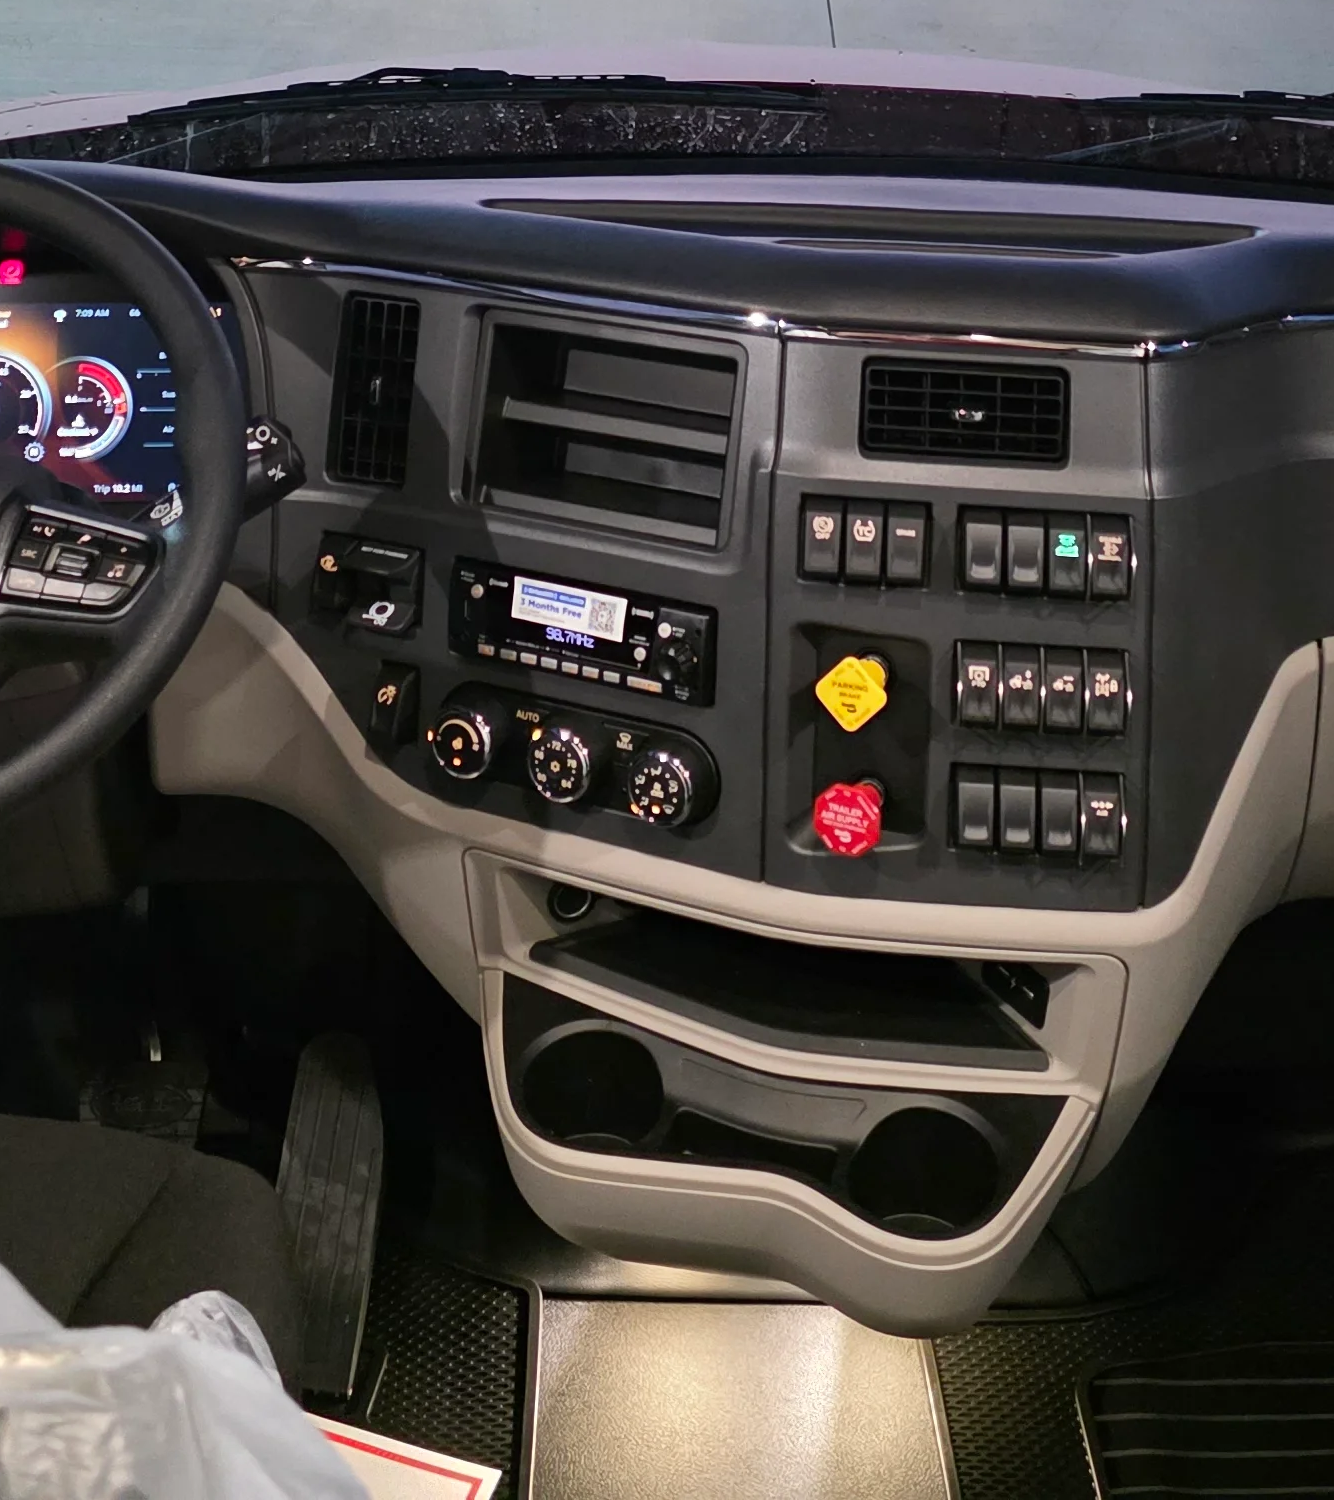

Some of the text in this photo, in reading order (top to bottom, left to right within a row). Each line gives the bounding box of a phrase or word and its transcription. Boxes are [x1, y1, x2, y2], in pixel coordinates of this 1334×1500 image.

[75, 308, 110, 318] 7:09 AM
[93, 484, 111, 495] Trip
[112, 484, 130, 493] 10.2
[858, 524, 872, 535] TC
[520, 597, 527, 606] 3
[528, 599, 560, 614] Months
[562, 606, 583, 619] Free
[545, 626, 595, 649] 98.7MHz
[831, 680, 869, 693] PARKING
[839, 691, 861, 700] BRAKE
[516, 709, 540, 723] AUTO
[552, 740, 562, 751] 72
[828, 802, 864, 819] TRAILER
[820, 809, 836, 821] AIR
[836, 813, 870, 829] SUPPLY
